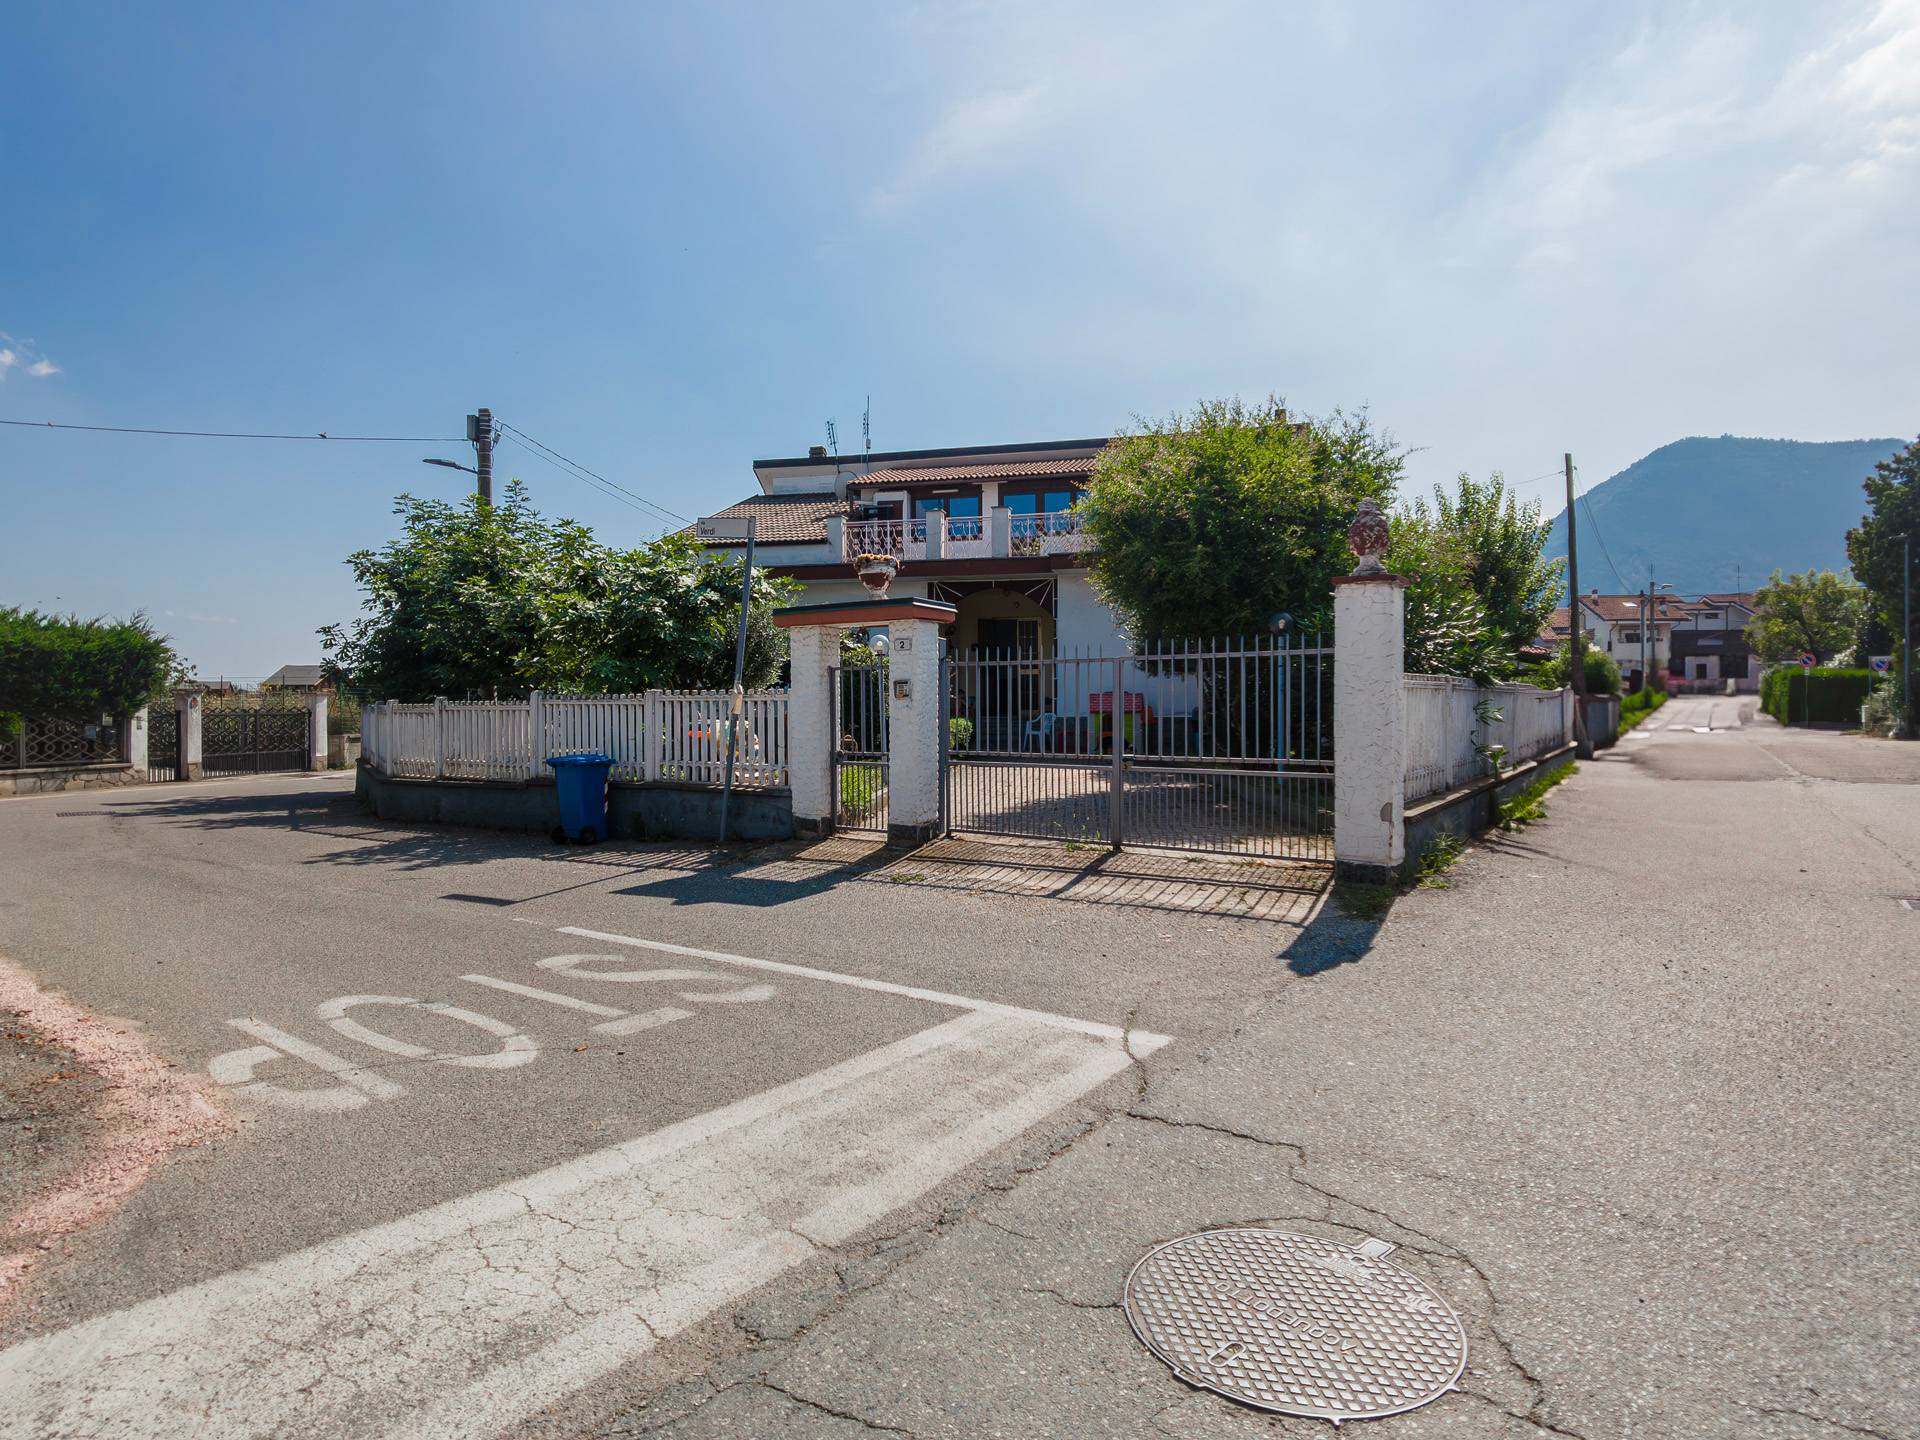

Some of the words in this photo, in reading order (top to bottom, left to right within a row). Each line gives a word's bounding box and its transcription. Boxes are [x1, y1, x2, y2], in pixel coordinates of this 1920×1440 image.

[700, 527, 715, 535] Verdi
[208, 953, 777, 1112] STOP
[1214, 1281, 1357, 1351] ACQUEDOTTO
